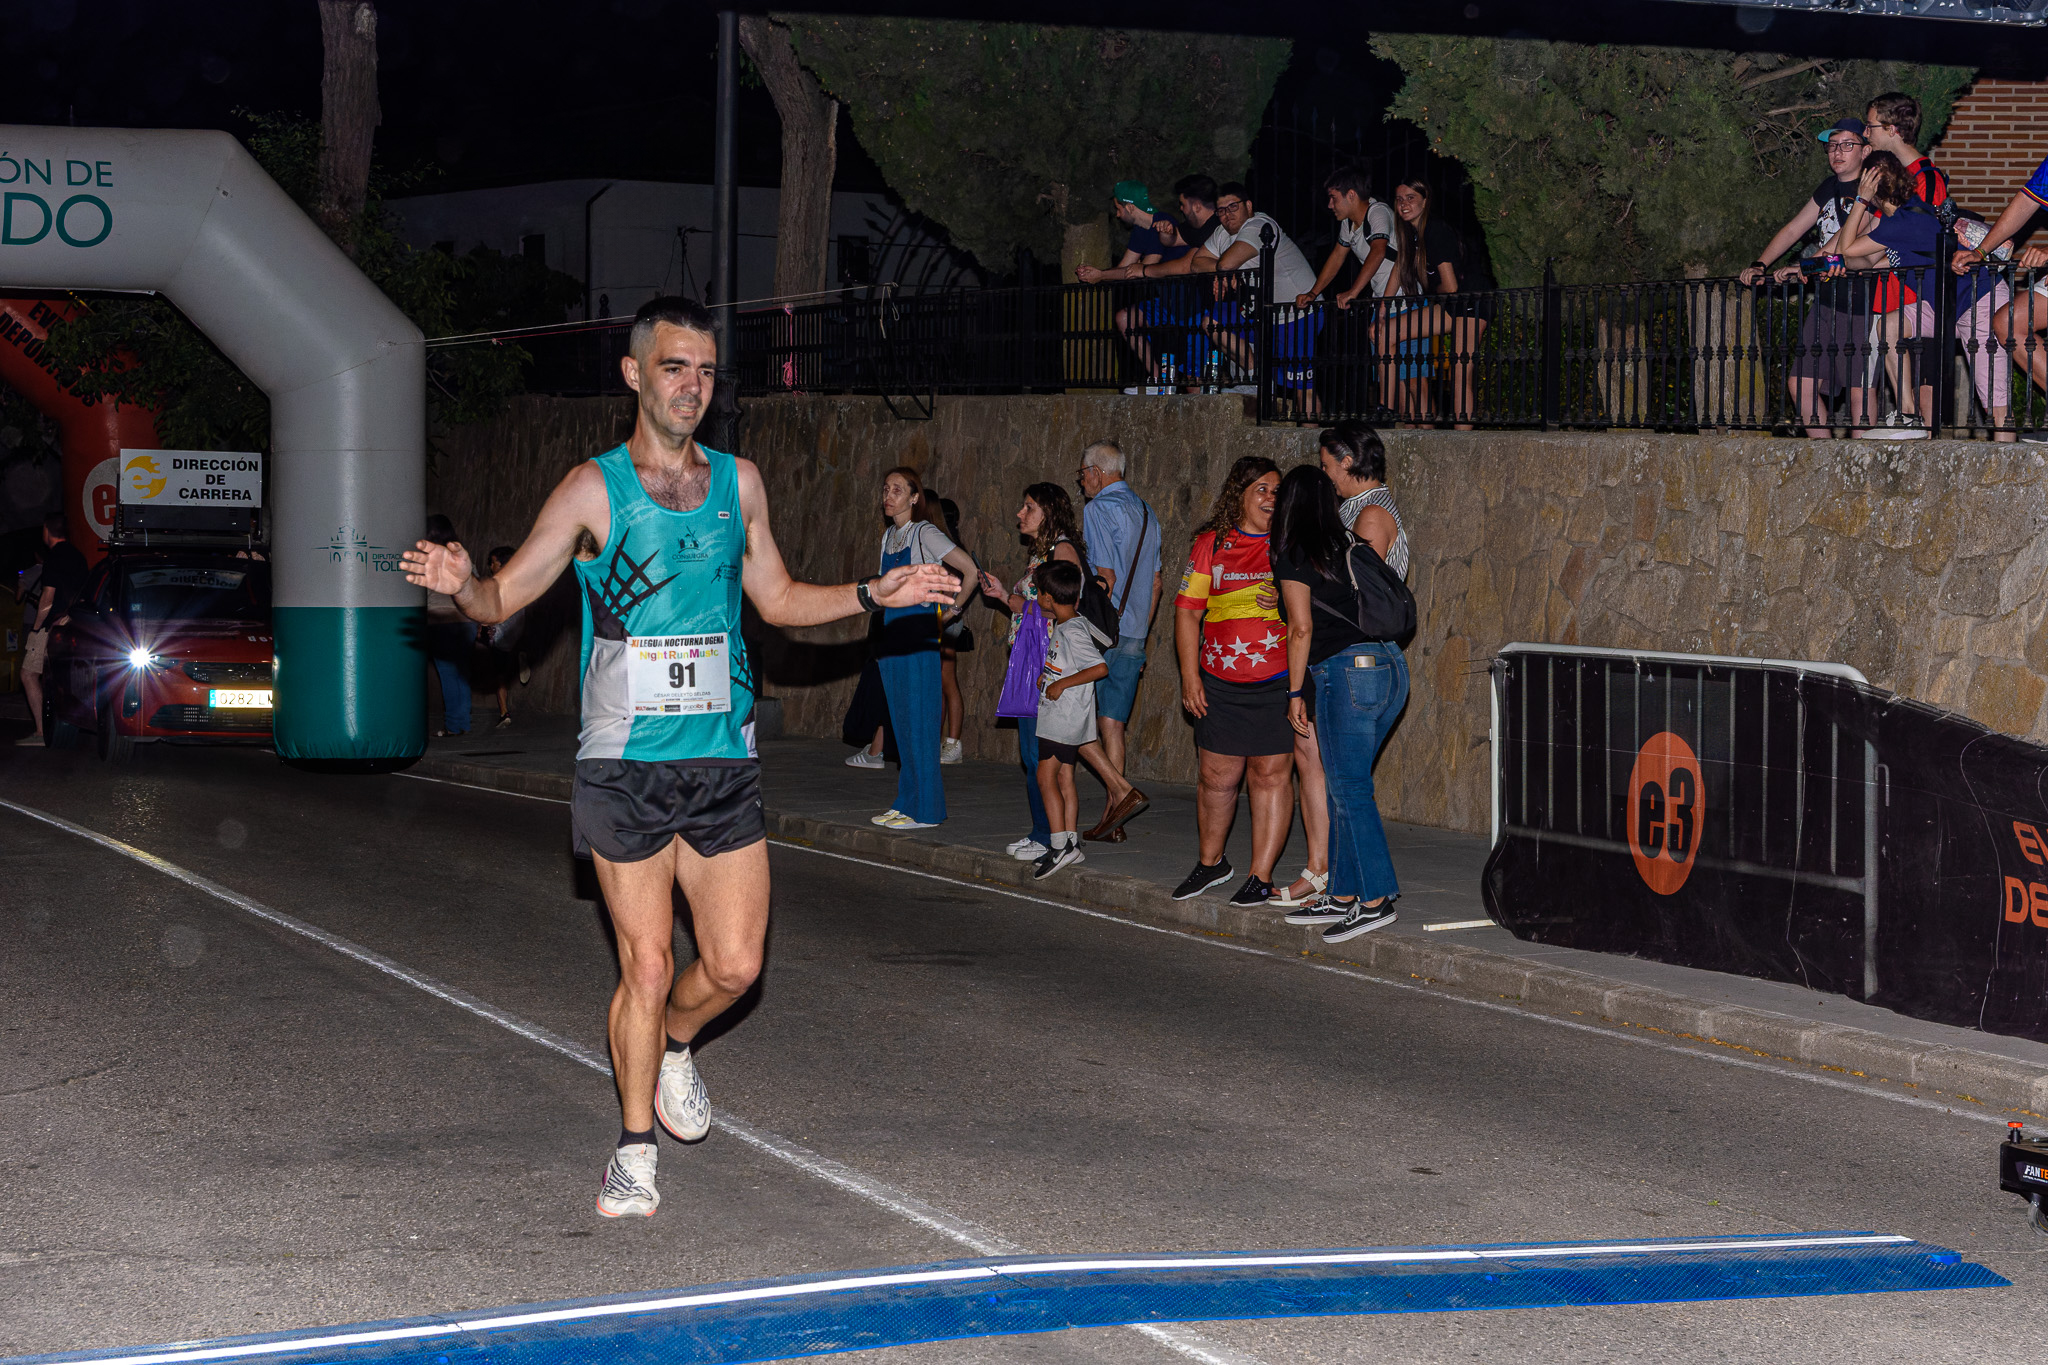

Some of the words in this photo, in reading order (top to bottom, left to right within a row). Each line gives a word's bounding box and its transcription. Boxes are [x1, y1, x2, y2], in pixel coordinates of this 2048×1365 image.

[0, 151, 52, 186] ÓN
[66, 160, 113, 187] DE
[1, 191, 113, 248] DO
[172, 456, 259, 472] DIRECCIÓN
[205, 474, 226, 485] DE
[179, 487, 252, 500] CARRERA
[92, 484, 117, 525] e
[372, 561, 403, 572] TOLE
[631, 639, 639, 648] XI
[640, 639, 662, 647] LEGUA
[664, 637, 703, 647] NOCTURNA
[669, 662, 696, 688] 91
[219, 692, 254, 705] 0282
[1638, 767, 1695, 864] e3
